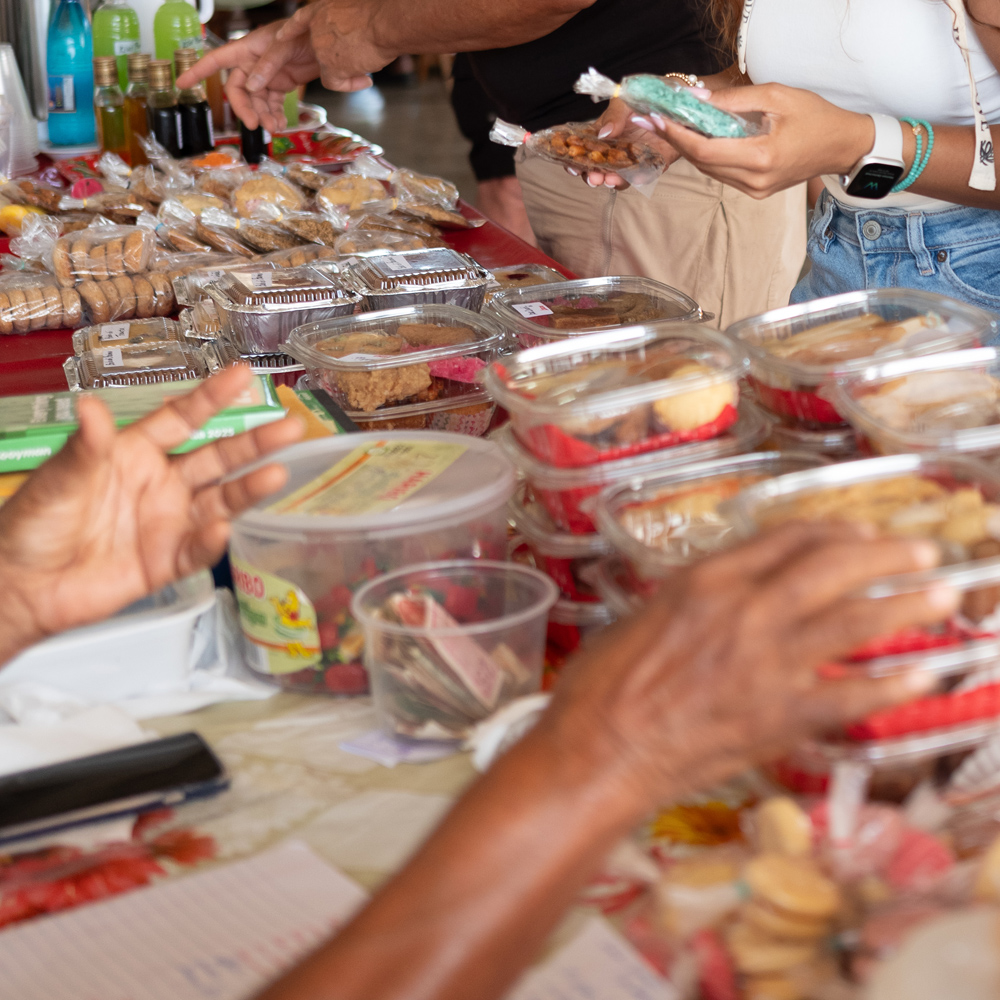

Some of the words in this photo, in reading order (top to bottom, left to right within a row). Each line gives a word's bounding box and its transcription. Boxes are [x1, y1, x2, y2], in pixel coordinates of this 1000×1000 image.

[207, 427, 235, 439] 2025
[0, 446, 52, 461] ooyman
[232, 565, 265, 598] RIBO
